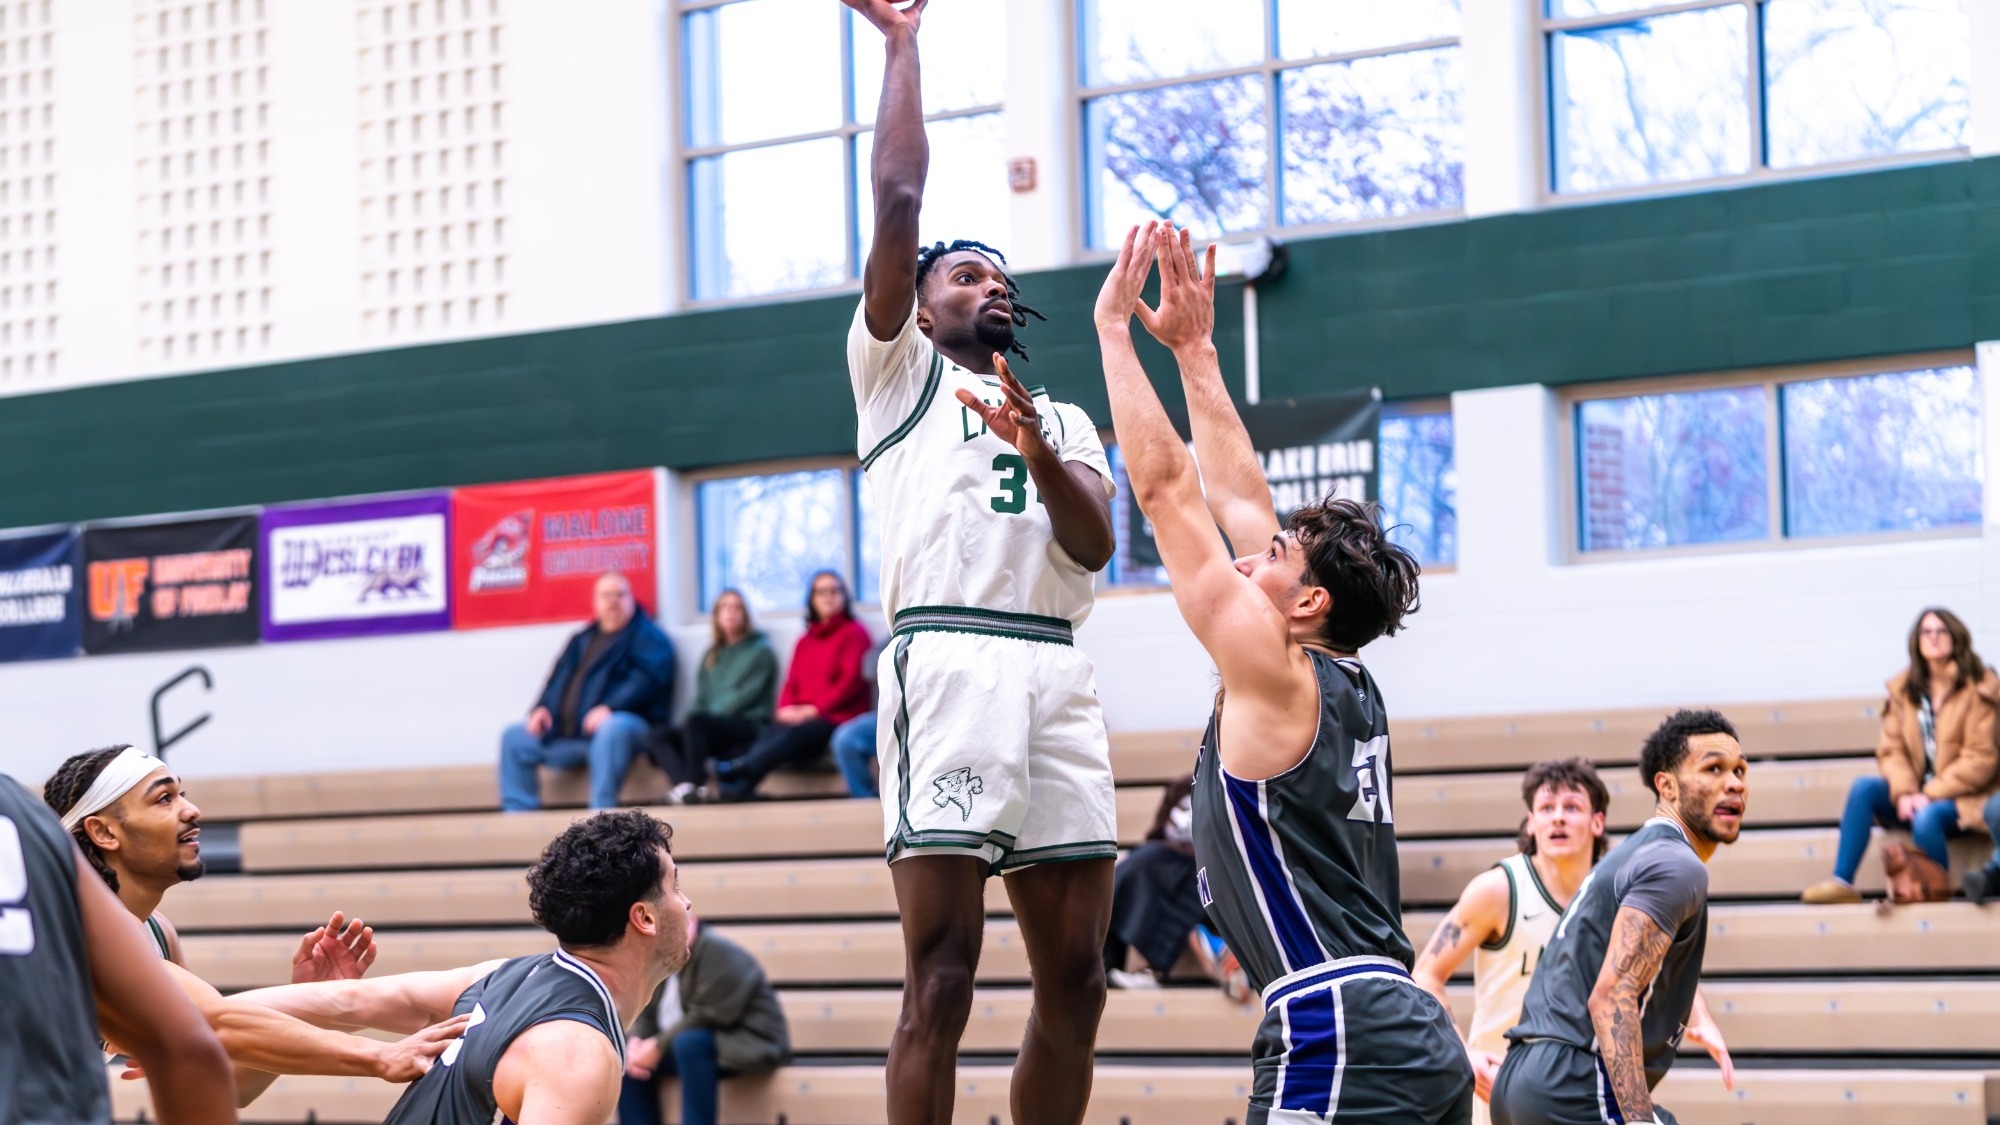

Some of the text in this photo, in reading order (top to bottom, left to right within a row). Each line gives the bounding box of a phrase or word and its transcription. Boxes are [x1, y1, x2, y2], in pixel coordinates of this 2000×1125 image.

[990, 453, 1044, 515] 3
[543, 505, 648, 542] MALONE
[87, 556, 149, 621] UF
